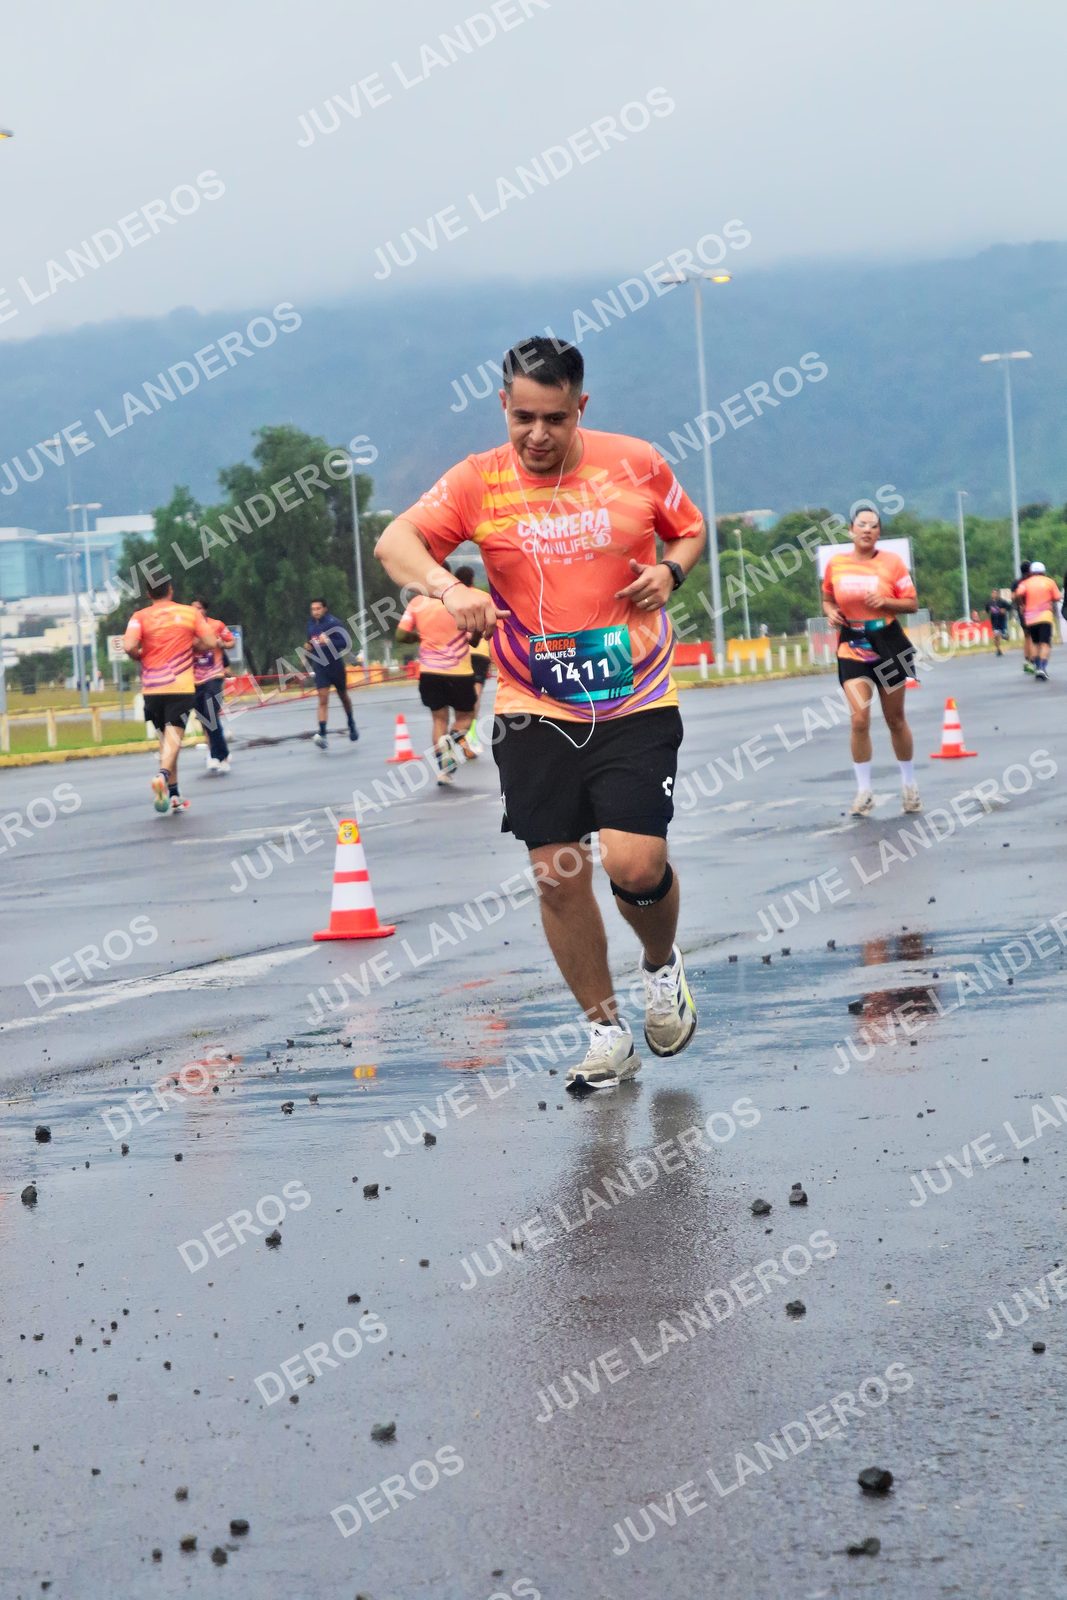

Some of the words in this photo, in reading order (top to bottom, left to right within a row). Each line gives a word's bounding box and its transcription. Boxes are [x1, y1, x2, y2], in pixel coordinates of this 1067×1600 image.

[517, 508, 611, 540] CARRERA
[522, 536, 591, 555] OMNILIFE
[534, 638, 576, 653] CARRERA
[603, 631, 621, 647] 10K
[551, 658, 610, 684] 1411
